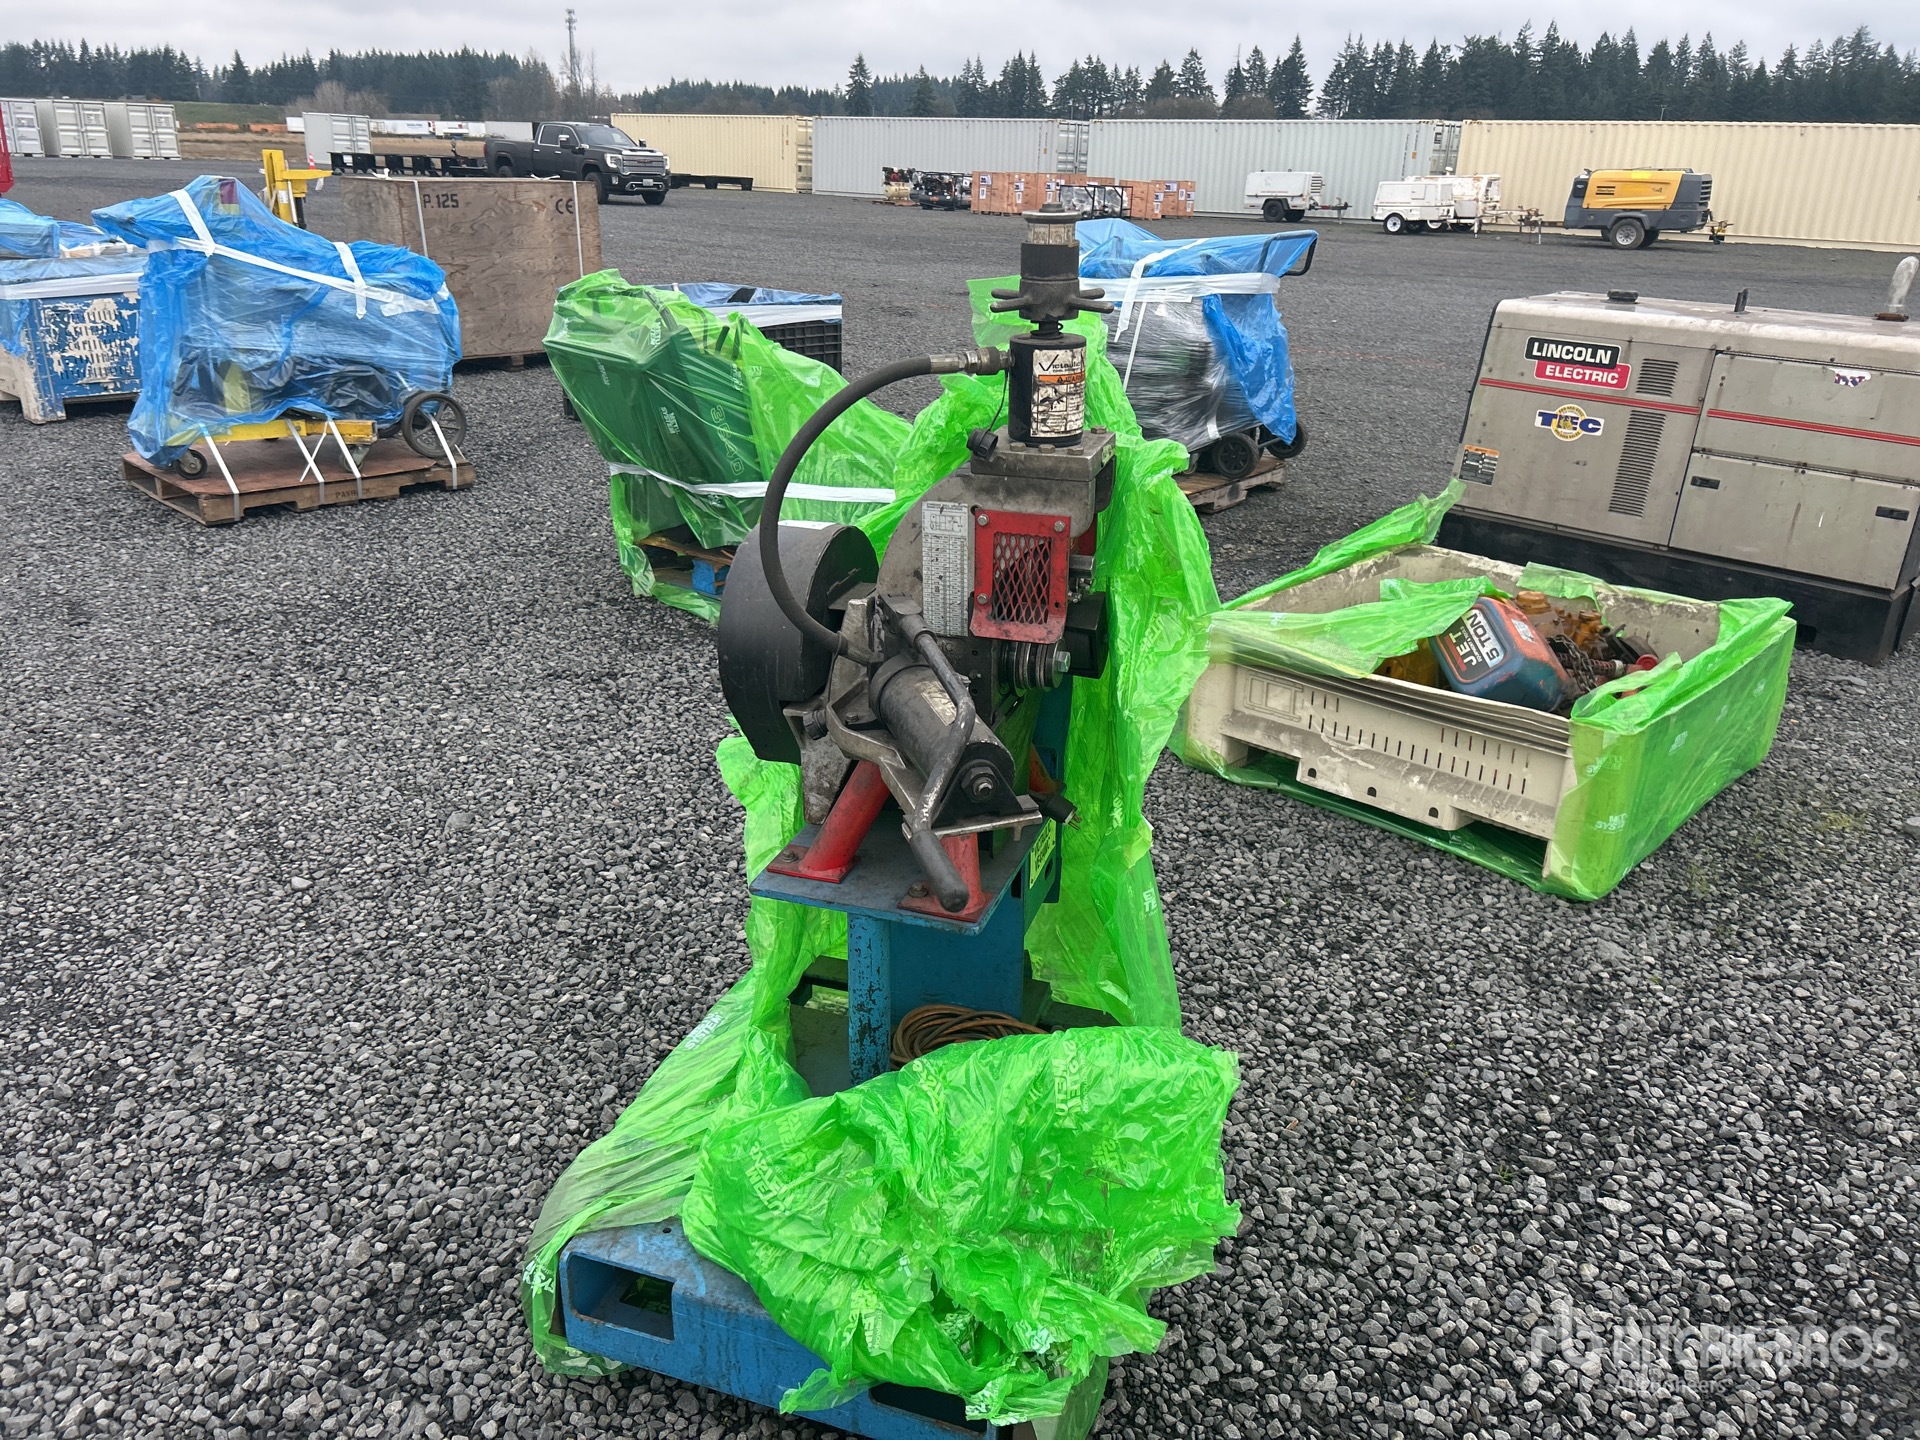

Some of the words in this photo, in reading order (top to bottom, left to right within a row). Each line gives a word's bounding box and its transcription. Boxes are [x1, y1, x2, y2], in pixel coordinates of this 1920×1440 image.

[423, 193, 459, 209] P.125
[1532, 342, 1611, 365] LINCOLN
[1545, 364, 1619, 384] ELECTRIC
[1466, 613, 1491, 648] TON
[1448, 631, 1477, 666] JET
[1486, 647, 1500, 661] 5
